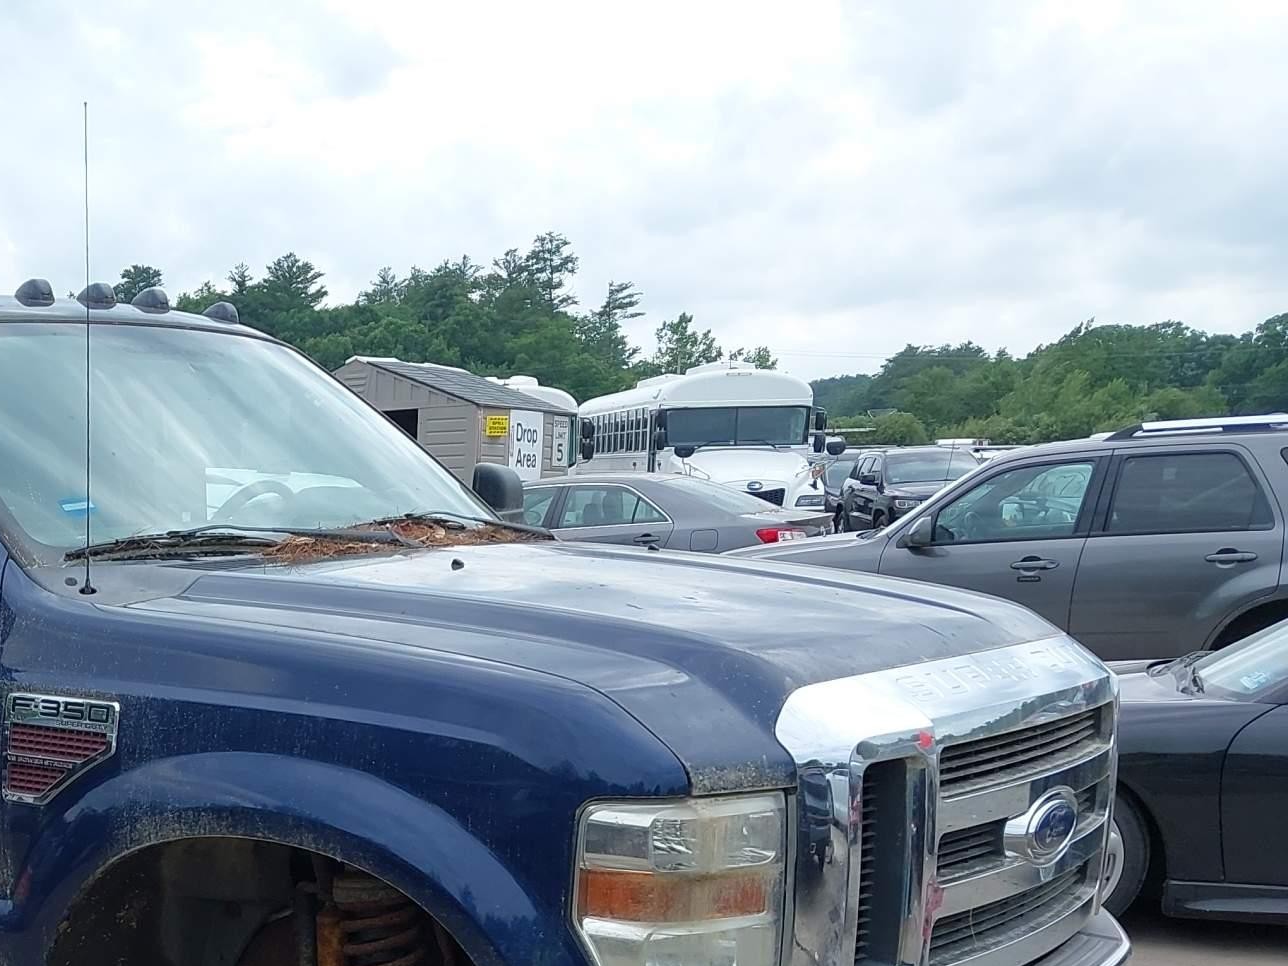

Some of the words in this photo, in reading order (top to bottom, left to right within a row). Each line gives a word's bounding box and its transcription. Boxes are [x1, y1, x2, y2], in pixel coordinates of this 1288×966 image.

[516, 422, 538, 447] Drop
[515, 448, 537, 468] Area
[556, 443, 564, 462] 5
[12, 697, 110, 723] F-350
